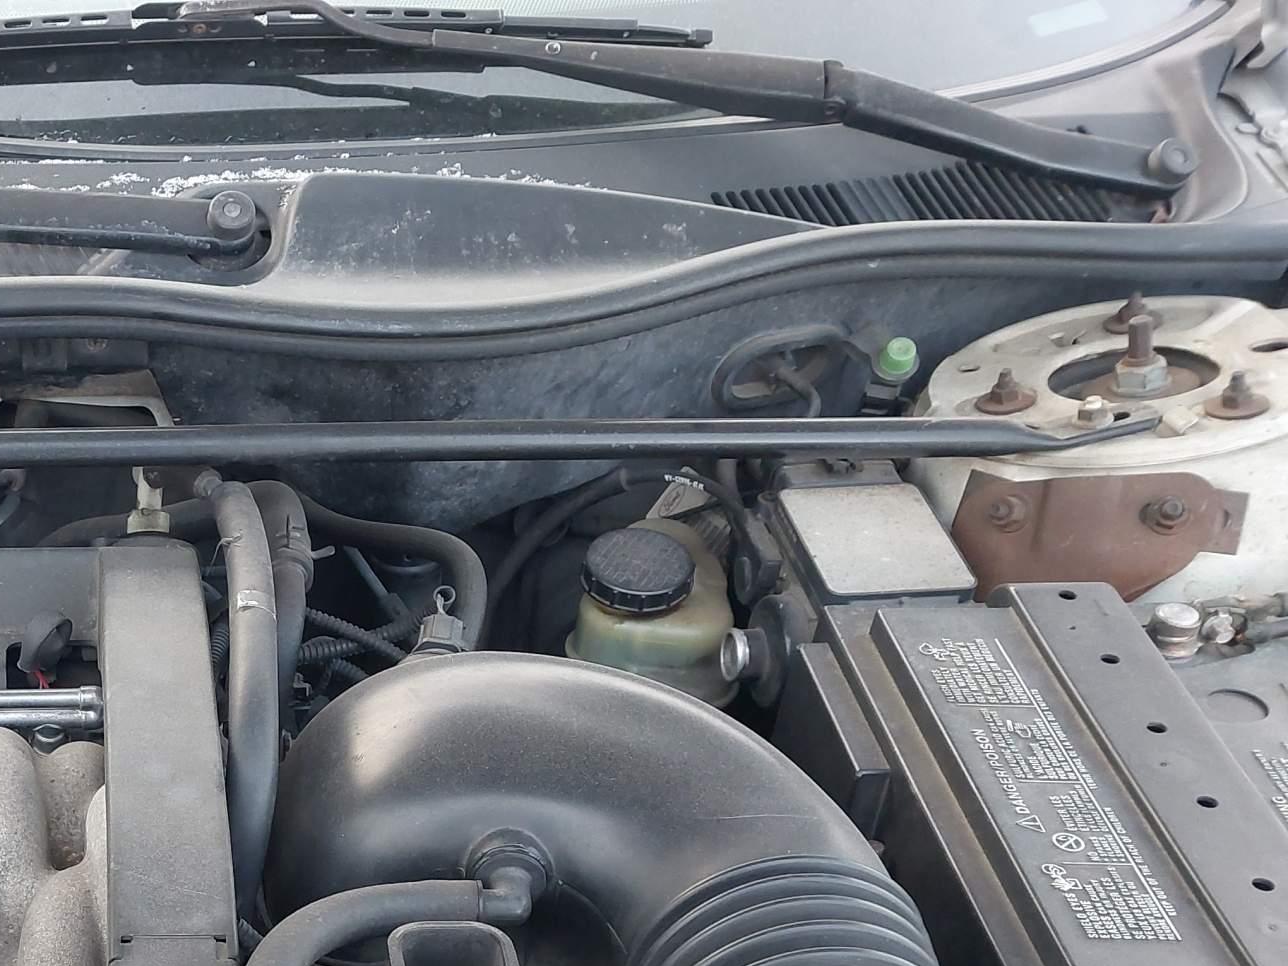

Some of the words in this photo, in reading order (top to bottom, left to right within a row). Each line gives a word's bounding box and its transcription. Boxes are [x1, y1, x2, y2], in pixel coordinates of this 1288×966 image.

[972, 729, 1029, 813] DANGER/POISON
[1063, 893, 1083, 910] EYES
[1076, 913, 1098, 937] SHIELD
[1080, 900, 1109, 938] EXPLOSIVE
[1100, 916, 1121, 938] GASES
